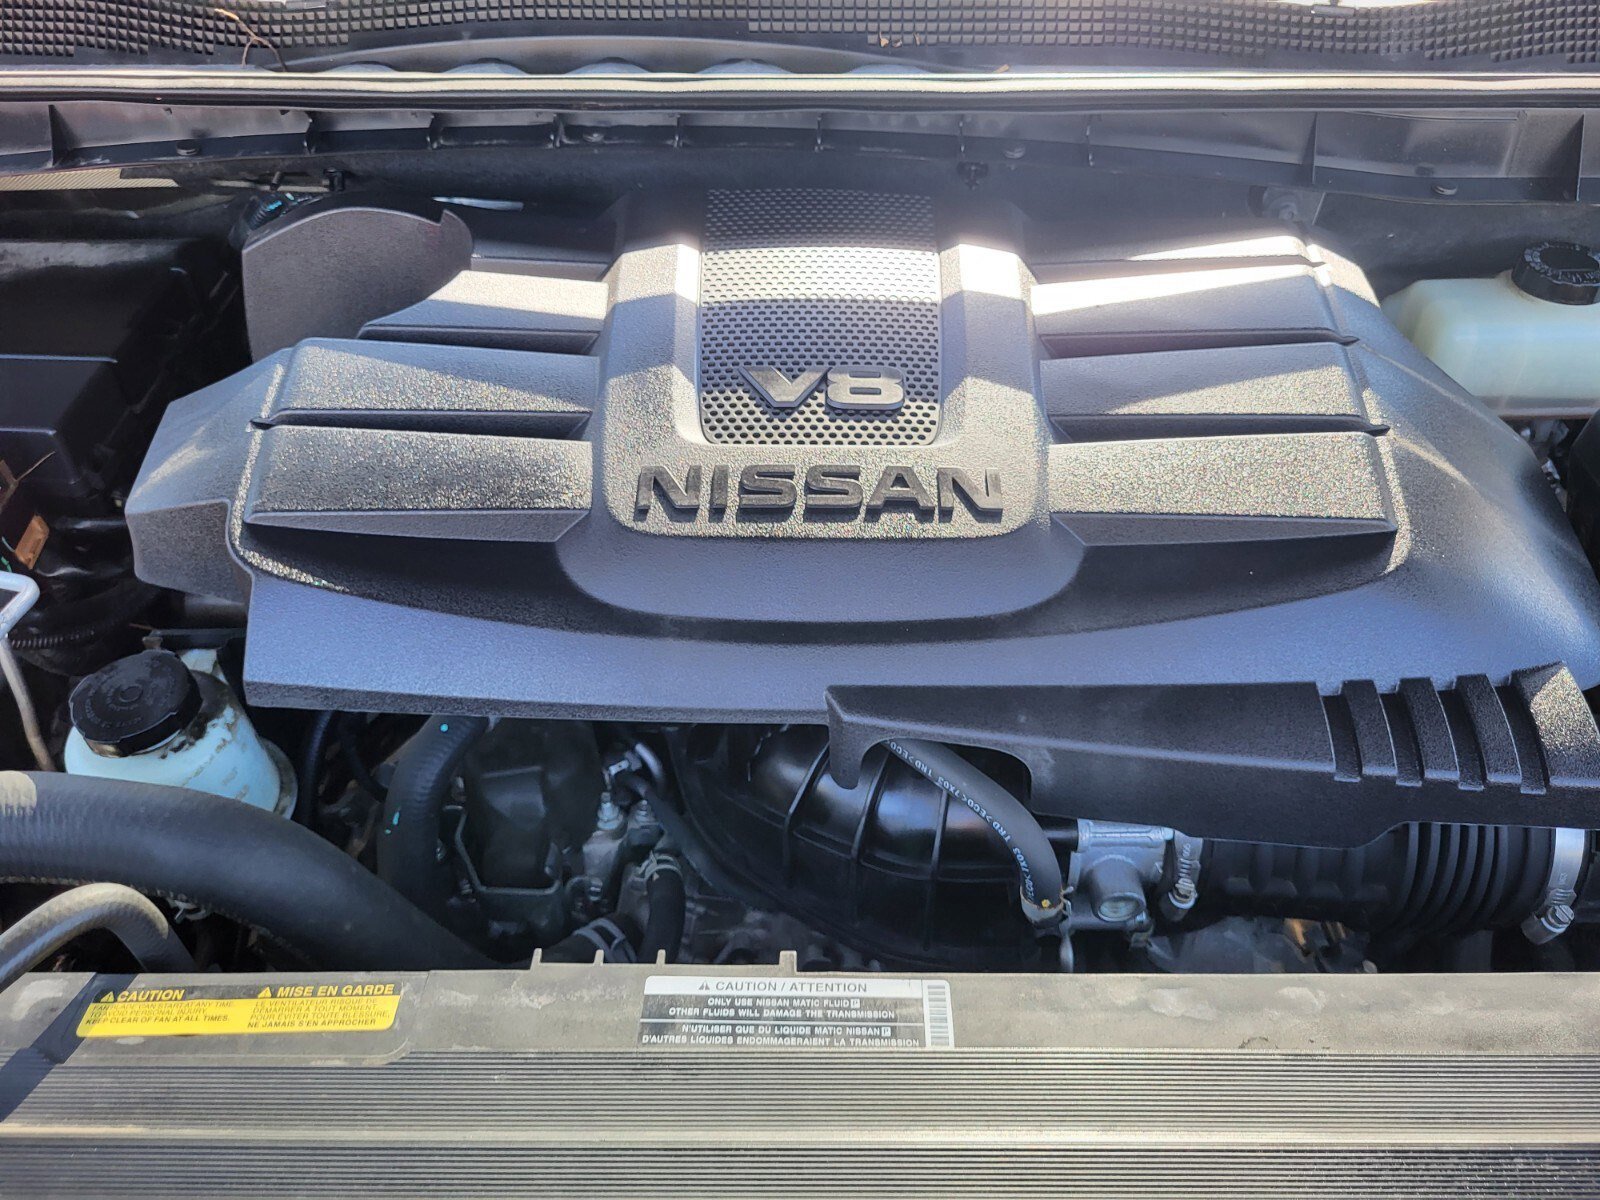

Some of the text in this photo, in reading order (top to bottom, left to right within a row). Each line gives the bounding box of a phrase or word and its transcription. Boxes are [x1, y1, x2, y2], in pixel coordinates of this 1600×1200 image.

[738, 366, 904, 409] V8
[635, 464, 1003, 513] NISSAN
[276, 983, 395, 998] MISE EN GARDE
[715, 981, 777, 992] CAUTION
[789, 982, 867, 993] ATTENTION
[117, 989, 185, 1002] CAUTION
[707, 997, 731, 1006] ONLY
[735, 998, 753, 1007] USE
[756, 998, 789, 1007] NISSAN
[792, 998, 819, 1008] MATIC
[823, 999, 850, 1008] FLUID
[668, 1007, 895, 1019] OTHER FLUIDS WILL DAMAGE THE TRANSMISSION
[262, 1020, 296, 1028] JAMAIS
[321, 1018, 377, 1026] APPROCHER
[682, 1024, 732, 1034] N'UTILISER
[735, 1025, 755, 1034] QUE
[758, 1025, 772, 1034] DU
[775, 1026, 811, 1035] LIQUIDE
[814, 1026, 843, 1035] MATIC
[846, 1027, 880, 1036] NISSAN
[642, 1034, 920, 1047] D'AUTRES LIQUIDES ENDOMMAGERAIENT LA TRANSMISSION
